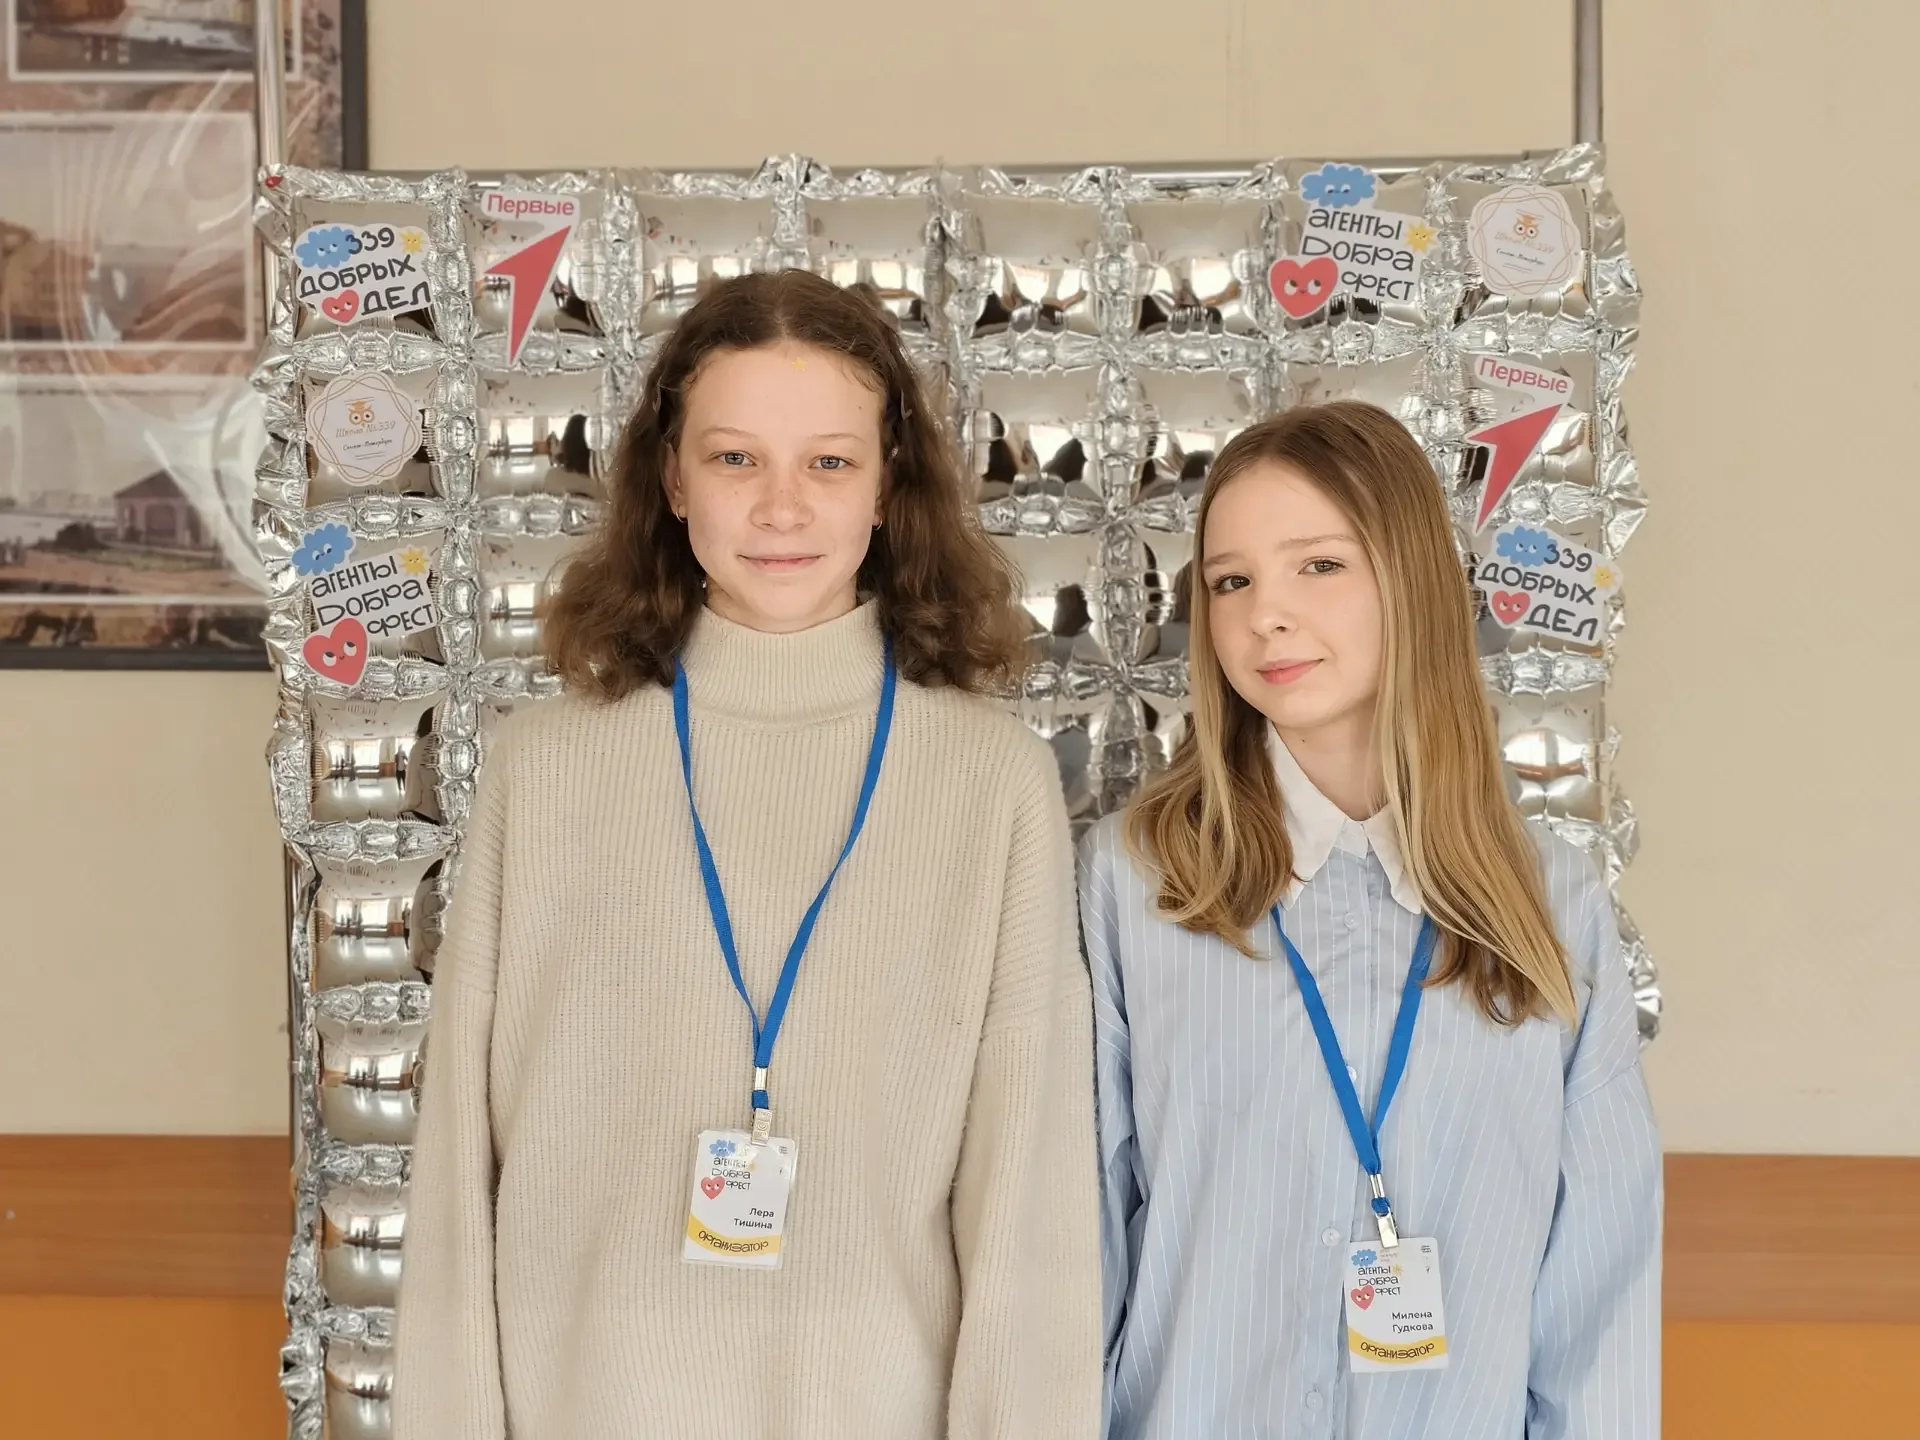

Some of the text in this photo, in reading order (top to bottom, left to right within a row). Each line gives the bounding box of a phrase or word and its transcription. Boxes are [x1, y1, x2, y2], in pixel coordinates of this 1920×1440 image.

[487, 194, 575, 217] Первые
[345, 227, 395, 255] 339
[299, 254, 416, 298] ДОБРЫХ
[361, 281, 431, 316] ДЕЛ
[1479, 357, 1568, 393] Первые
[1543, 543, 1593, 572] 339
[1478, 562, 1597, 605] ДОБРЫХ
[1524, 604, 1598, 641] ДЕЛ
[734, 1218, 773, 1229] Тишина
[749, 1208, 775, 1218] Лера
[1392, 1311, 1433, 1320] Милена
[1392, 1324, 1434, 1334] Гудкова
